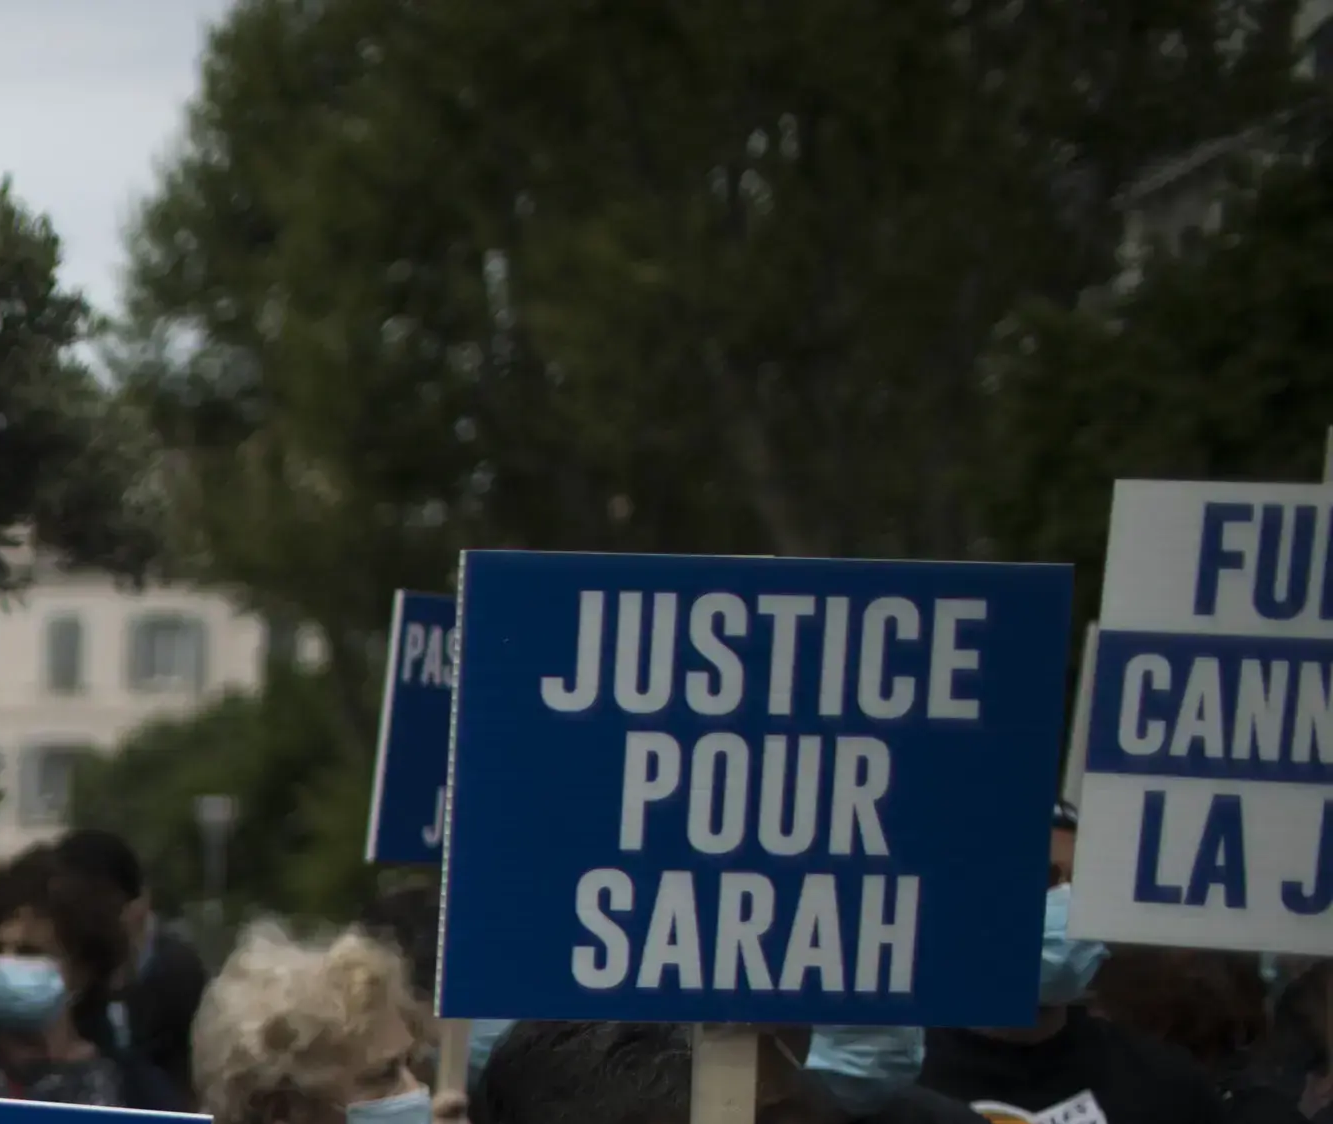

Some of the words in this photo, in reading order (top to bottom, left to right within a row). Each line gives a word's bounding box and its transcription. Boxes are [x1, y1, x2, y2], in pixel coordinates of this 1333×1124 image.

[402, 620, 457, 688] PAS
[540, 590, 988, 720] JUSTICE
[619, 731, 891, 856] POUR
[1134, 790, 1247, 909] LA
[571, 868, 921, 994] SARAH
